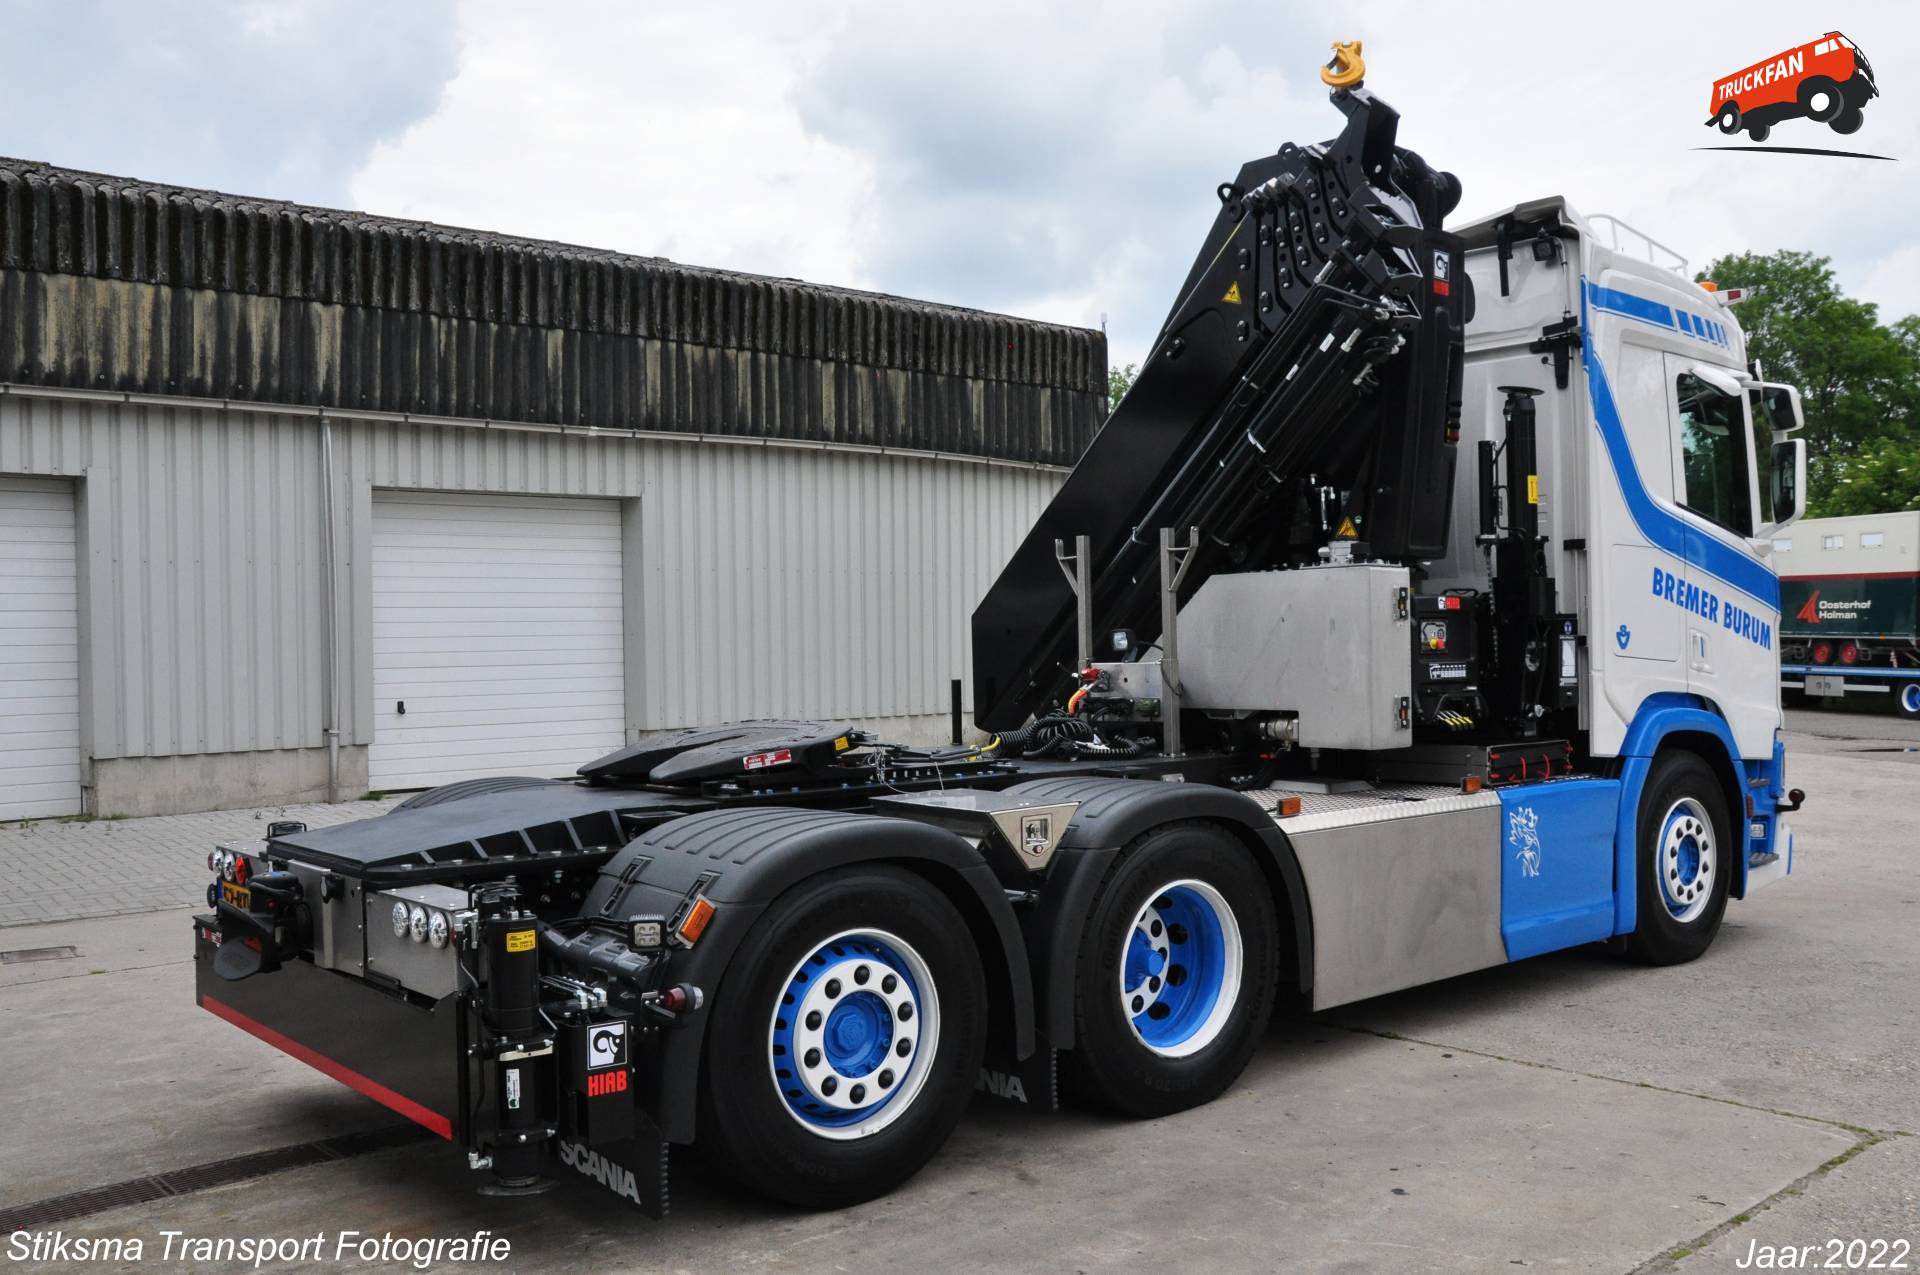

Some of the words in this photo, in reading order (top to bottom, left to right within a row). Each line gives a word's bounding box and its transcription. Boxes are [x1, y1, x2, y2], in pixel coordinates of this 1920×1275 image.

[1652, 566, 1719, 624] BREMER
[1723, 601, 1771, 650] BURUM
[1818, 600, 1872, 609] Oosterhof
[1818, 610, 1857, 619] Holman
[587, 1070, 628, 1097] HIAB
[559, 1139, 642, 1205] SCANIA
